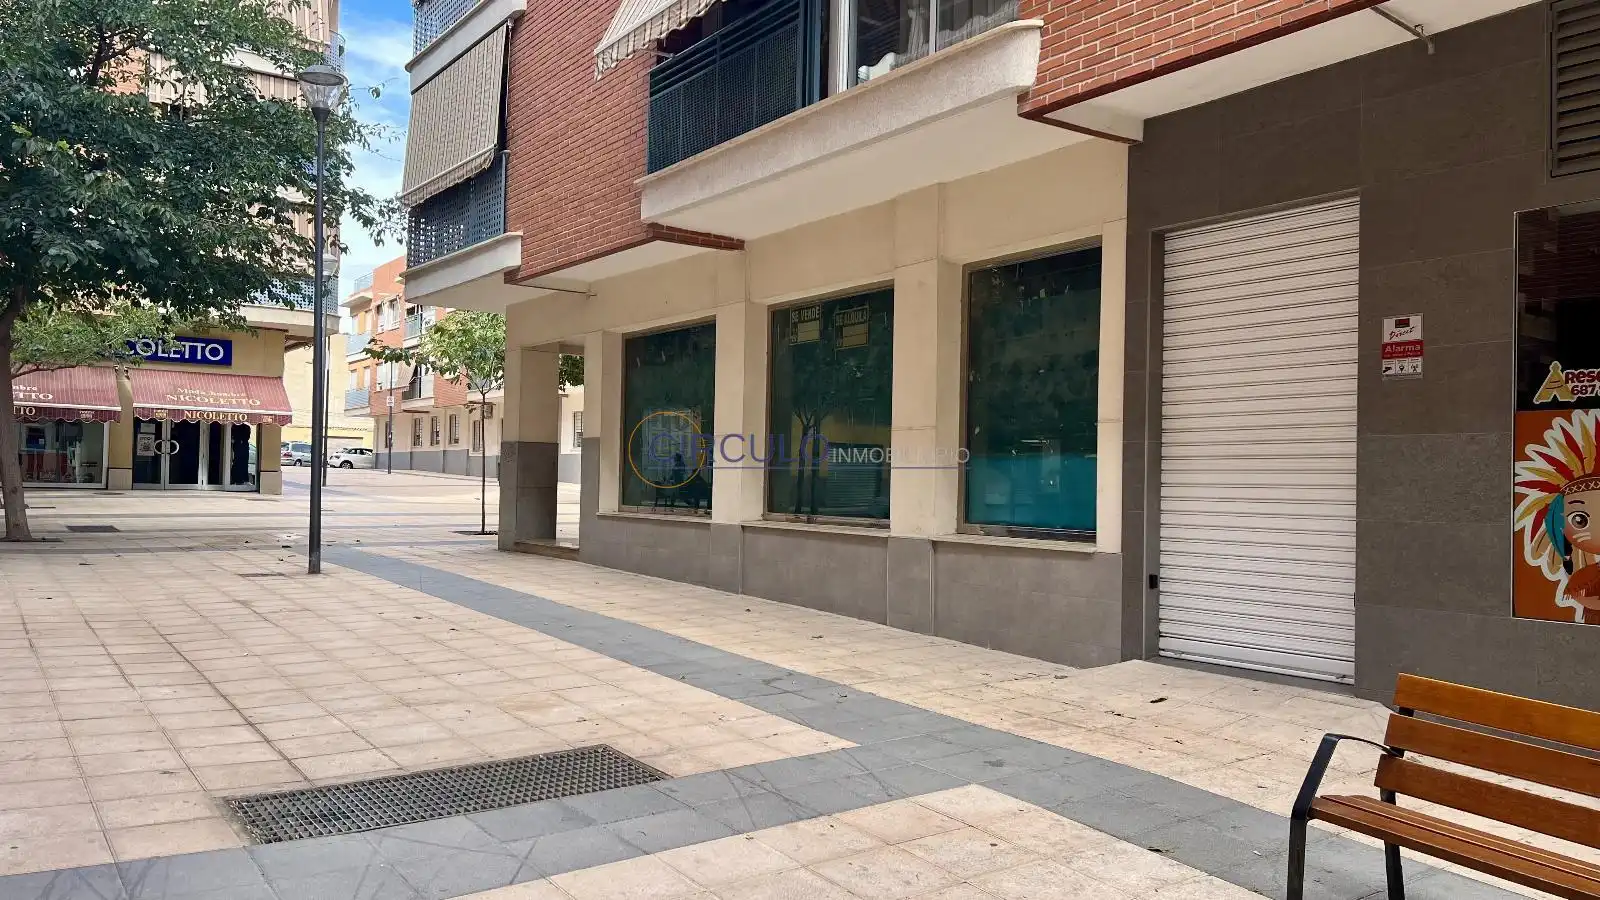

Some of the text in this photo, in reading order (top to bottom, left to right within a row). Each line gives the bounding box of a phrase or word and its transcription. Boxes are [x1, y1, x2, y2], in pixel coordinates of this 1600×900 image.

[791, 306, 820, 323] SE VENDE
[1385, 344, 1421, 352] Alarma
[165, 394, 261, 406] NICOLETTO
[184, 410, 248, 421] NICOLETTO
